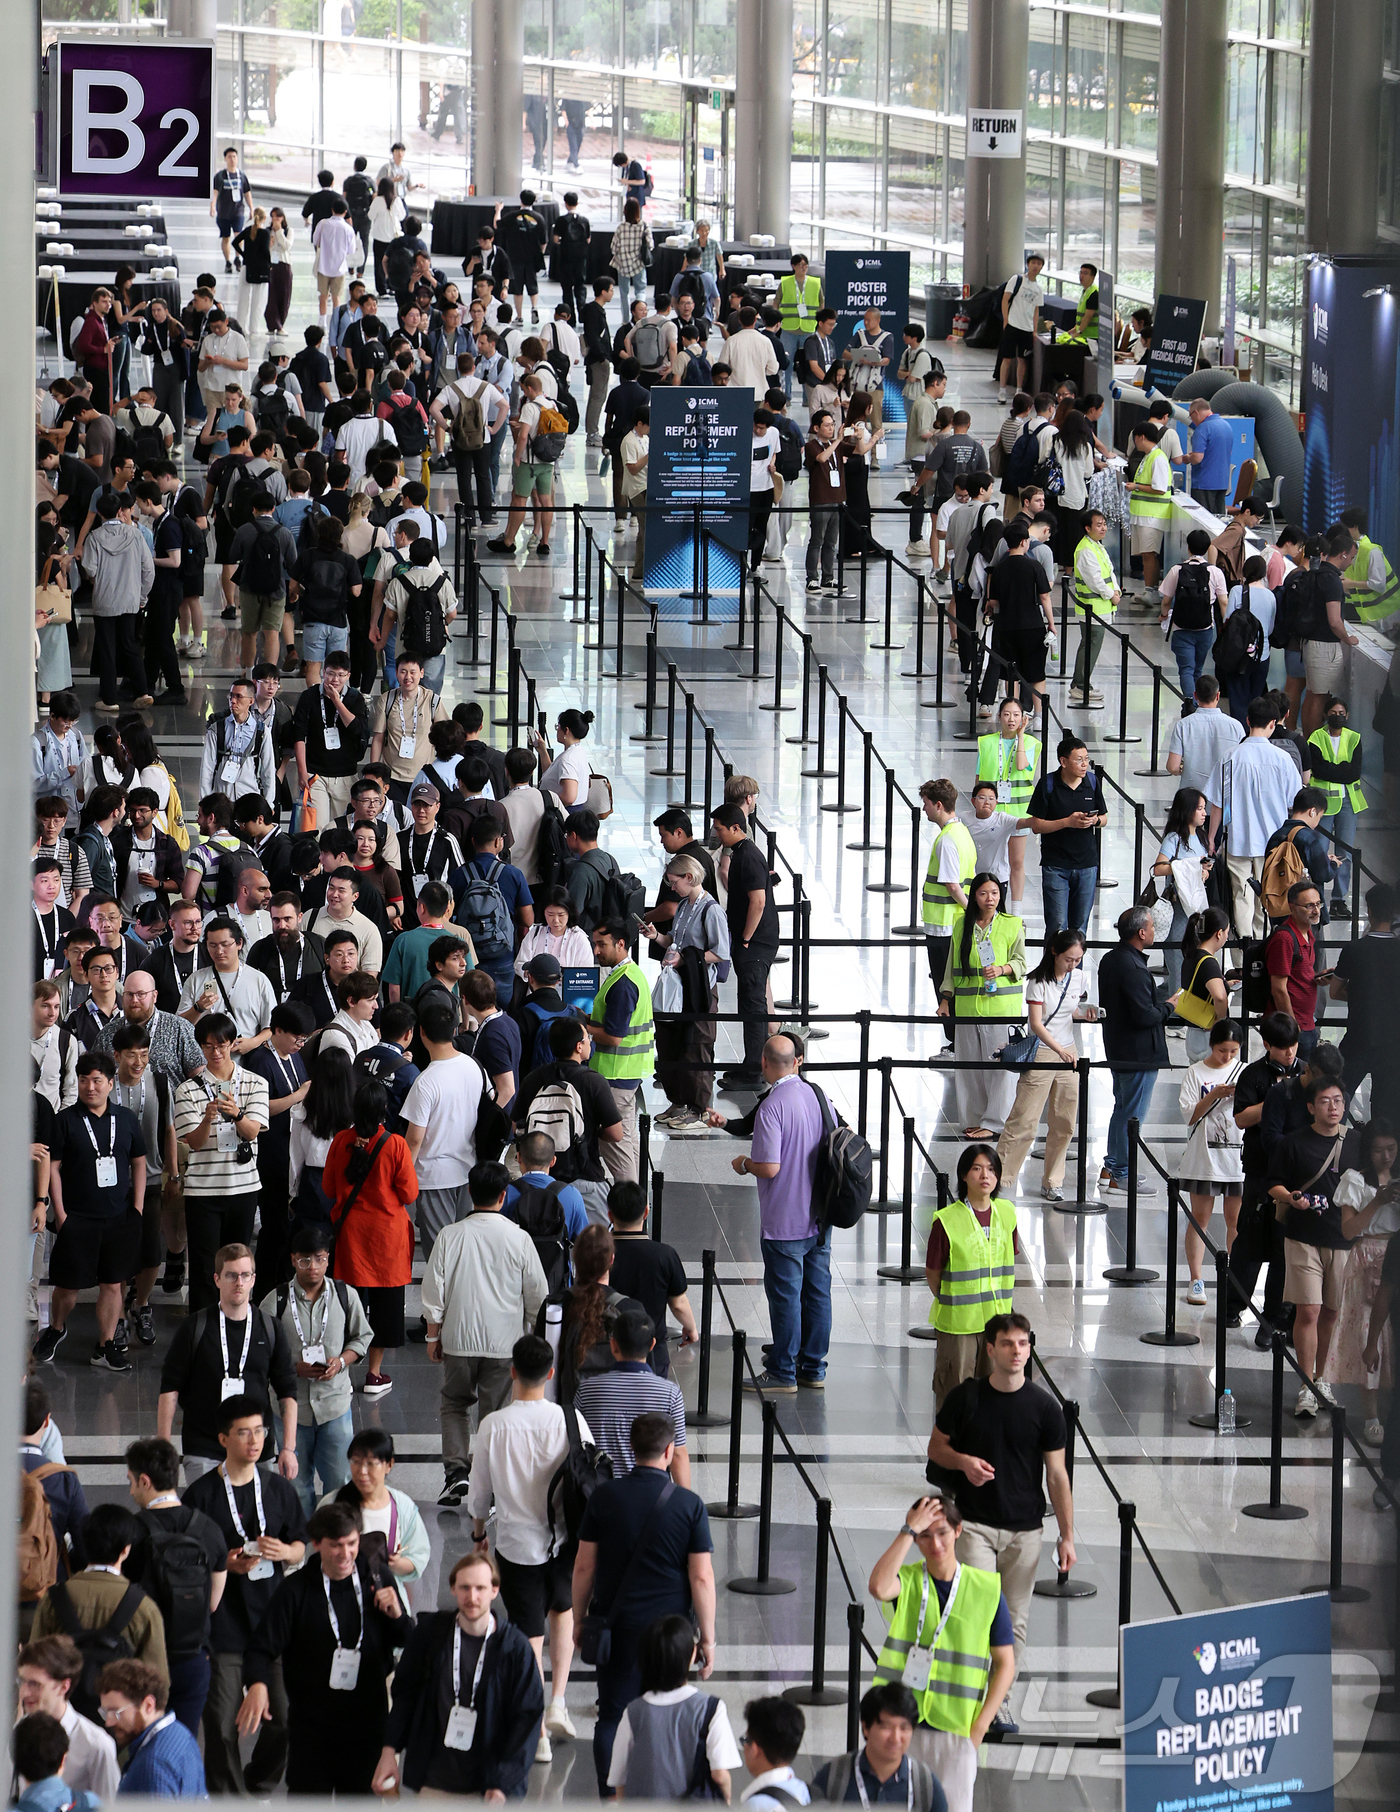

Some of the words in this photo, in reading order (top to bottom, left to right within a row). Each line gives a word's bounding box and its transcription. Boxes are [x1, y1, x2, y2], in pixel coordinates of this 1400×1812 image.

[972, 117, 1017, 133] RETURN
[847, 281, 887, 293] POSTER
[847, 295, 871, 306] PICK
[873, 295, 887, 306] UP
[1161, 338, 1178, 351] FIRST
[1176, 341, 1188, 353] AID
[1151, 349, 1174, 363] MEDICAL
[1174, 353, 1194, 366] OFFICE
[685, 413, 720, 424] BAGE
[665, 426, 738, 436] REPLAMENT
[683, 438, 719, 449] POCY
[1219, 1636, 1261, 1660] ICML
[1195, 1678, 1264, 1717] BADGE
[1156, 1705, 1302, 1758] REPLACEMENT
[1194, 1745, 1267, 1785] POLICY
[1188, 1796, 1196, 1809] is
[1229, 1788, 1240, 1801] for
